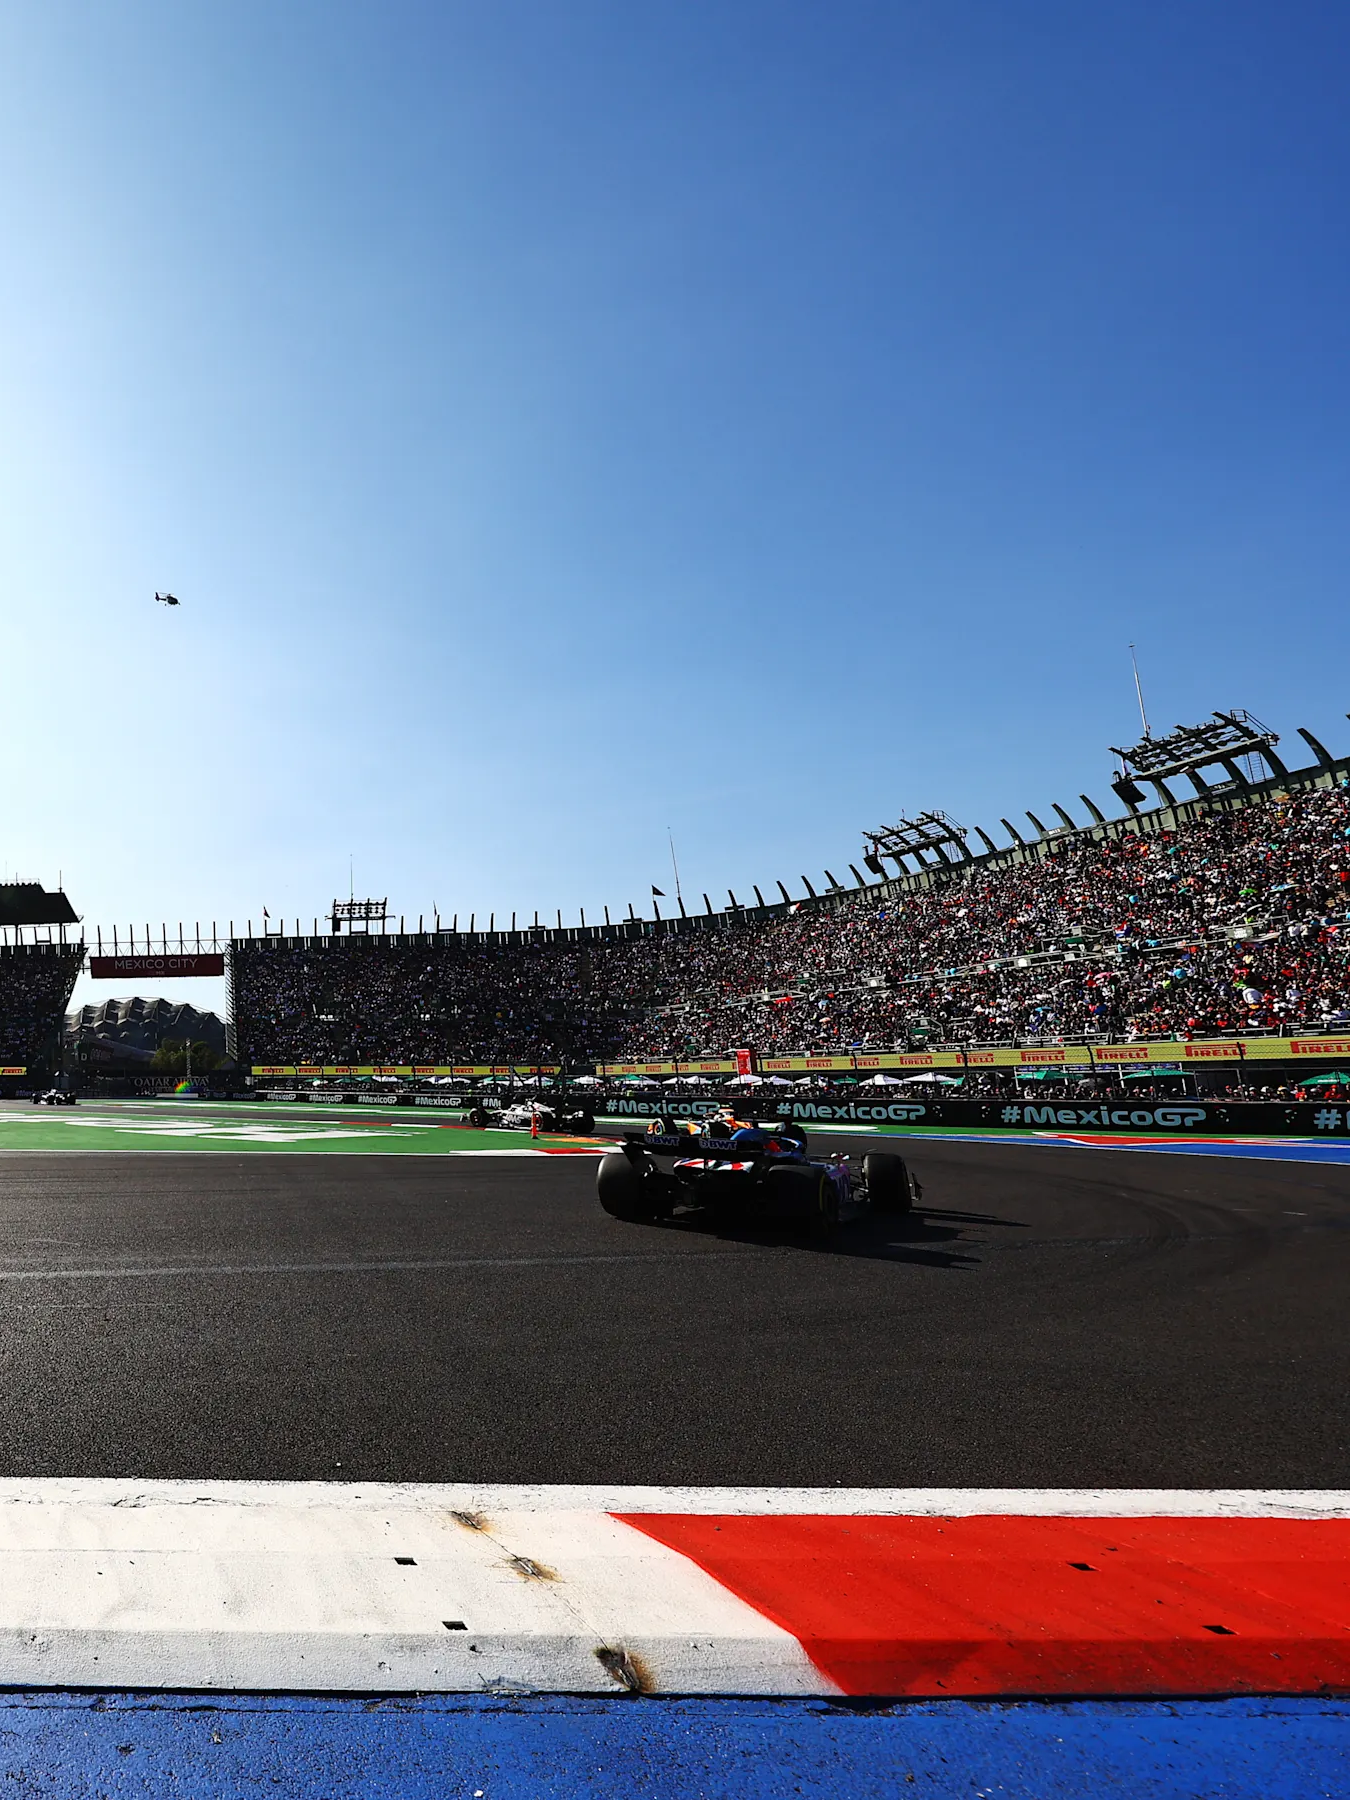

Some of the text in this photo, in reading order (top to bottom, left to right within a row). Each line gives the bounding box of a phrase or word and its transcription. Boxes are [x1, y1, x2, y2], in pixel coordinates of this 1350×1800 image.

[114, 957, 199, 970] MEXICO CITY
[1096, 1047, 1149, 1060] PIRELLI
[1185, 1043, 1247, 1057] PIRELLI
[850, 1057, 880, 1067] PRELLI
[900, 1055, 934, 1065] PIRELLI
[1020, 1050, 1066, 1063] PIRELLI
[767, 1060, 791, 1069] PIRELLI
[806, 1058, 833, 1068] PIRELLI
[134, 1077, 170, 1087] QATAR
[308, 1094, 344, 1103] #MexicoGP
[357, 1095, 398, 1105] #MexicoGP
[414, 1096, 462, 1107] #MexicoGP
[606, 1099, 720, 1117] #MexicoGP
[776, 1102, 926, 1121] #MexicoGP
[1000, 1105, 1207, 1128] #MexicoGP
[654, 1136, 679, 1147] BWT
[709, 1139, 738, 1151] BWT
